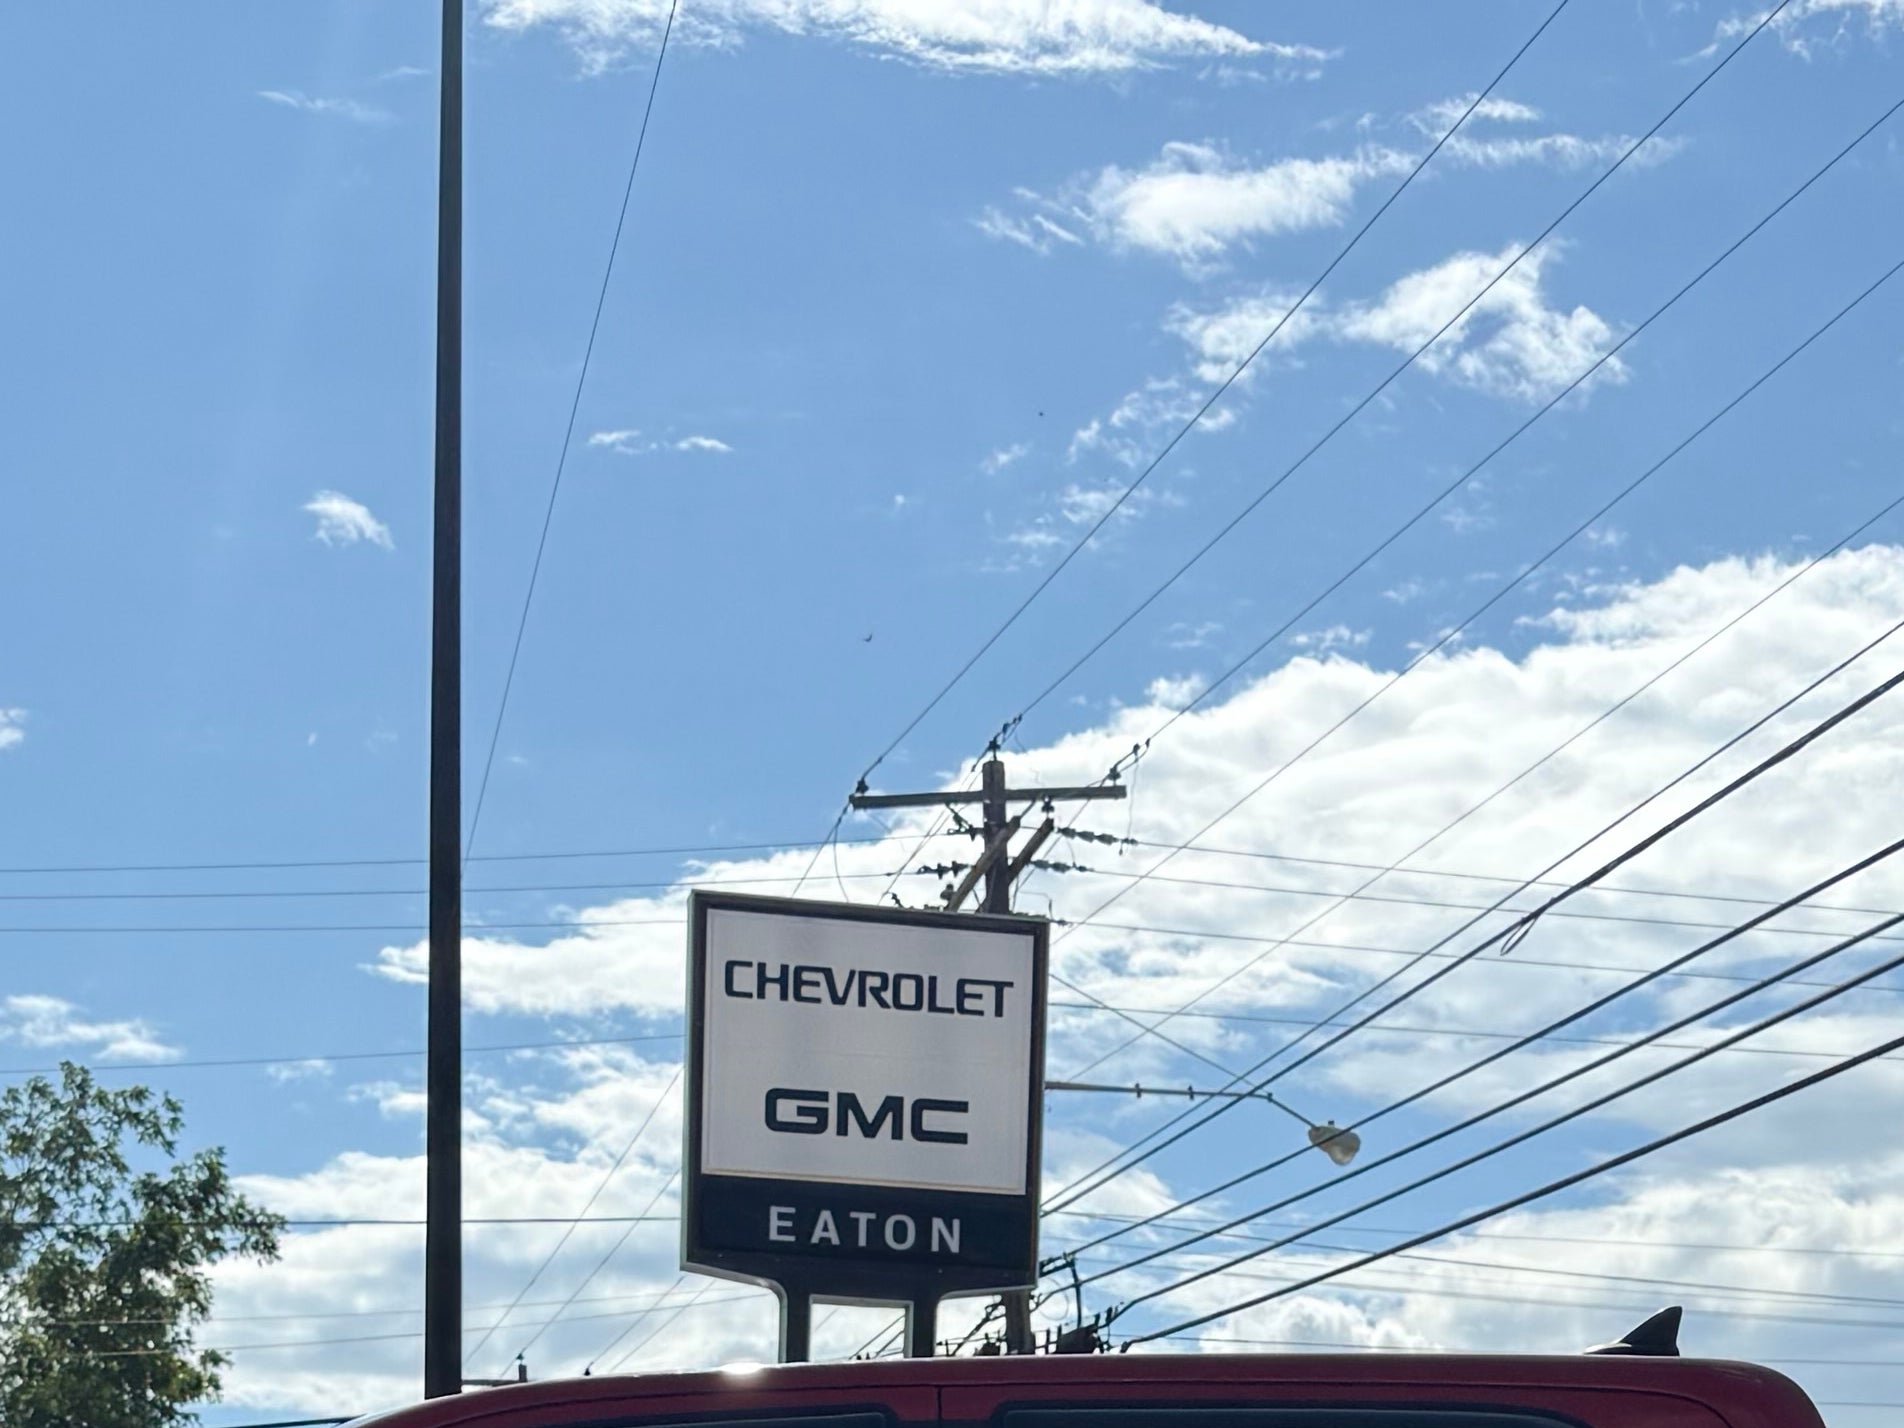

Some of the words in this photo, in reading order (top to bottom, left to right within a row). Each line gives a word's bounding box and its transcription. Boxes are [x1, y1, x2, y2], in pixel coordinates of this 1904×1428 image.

[724, 959, 1014, 1017] CHEVROLET
[764, 1087, 969, 1145] GMC
[769, 1205, 961, 1253] EATON
